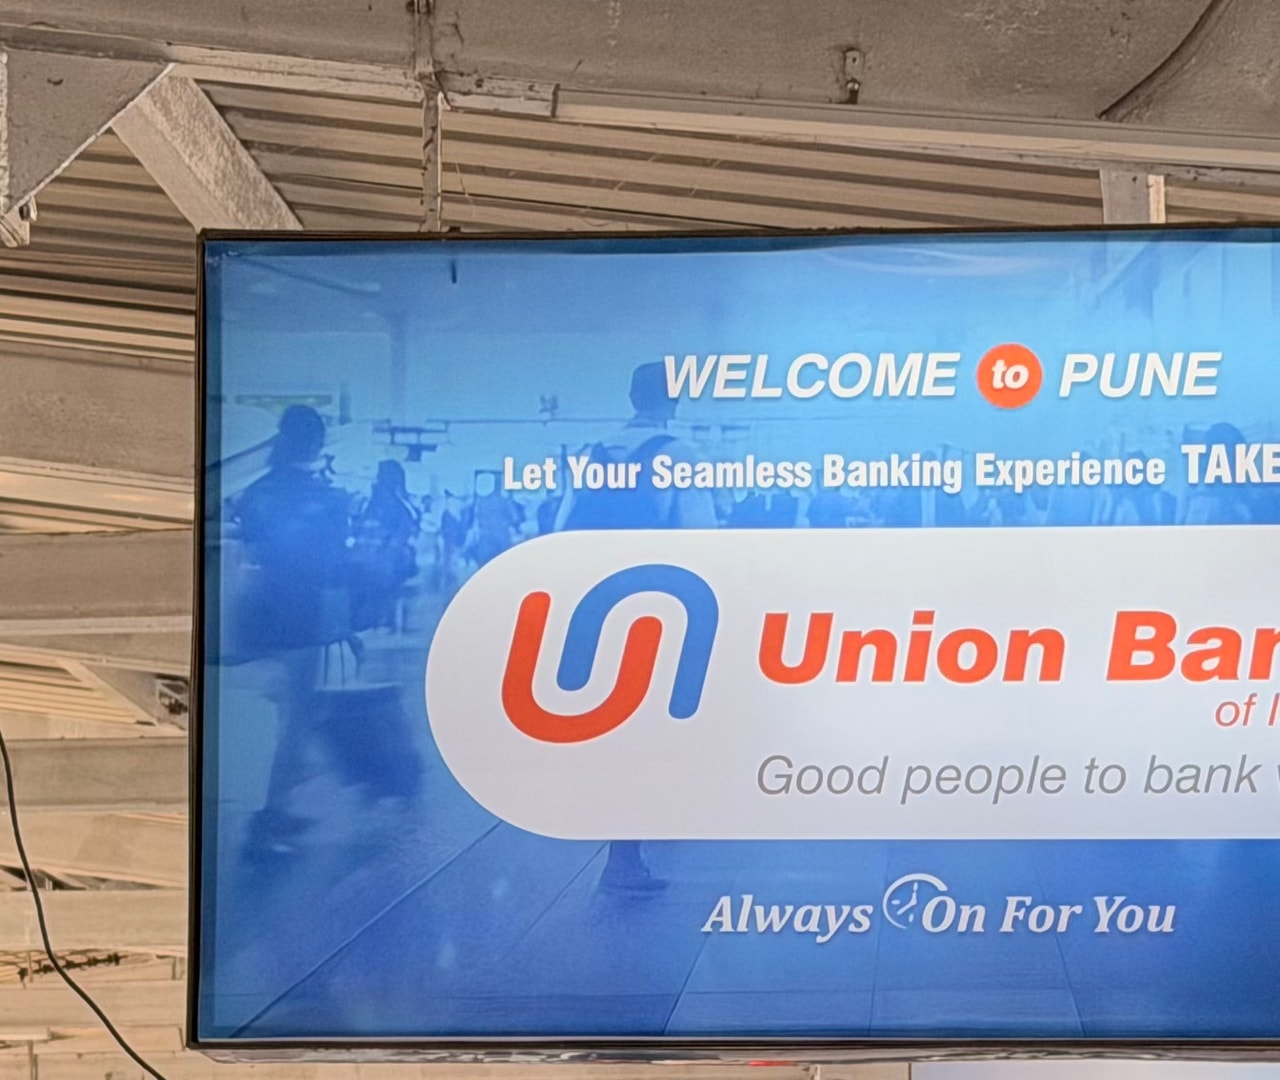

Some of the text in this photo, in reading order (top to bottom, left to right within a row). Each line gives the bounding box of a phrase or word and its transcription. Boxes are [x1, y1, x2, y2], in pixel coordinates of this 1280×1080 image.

[664, 352, 1222, 398] WELCOME to PUNE
[504, 457, 556, 490] Let
[568, 456, 641, 489] Your
[652, 454, 812, 489] Seamless
[824, 454, 962, 494] Banking
[976, 453, 1166, 493] Experience
[757, 609, 1065, 684] Union
[1214, 693, 1257, 727] of
[757, 755, 888, 795] Good
[900, 755, 1066, 804] people
[1083, 756, 1126, 794] to
[1144, 755, 1261, 793] bank
[701, 894, 1175, 944] Always On For You
